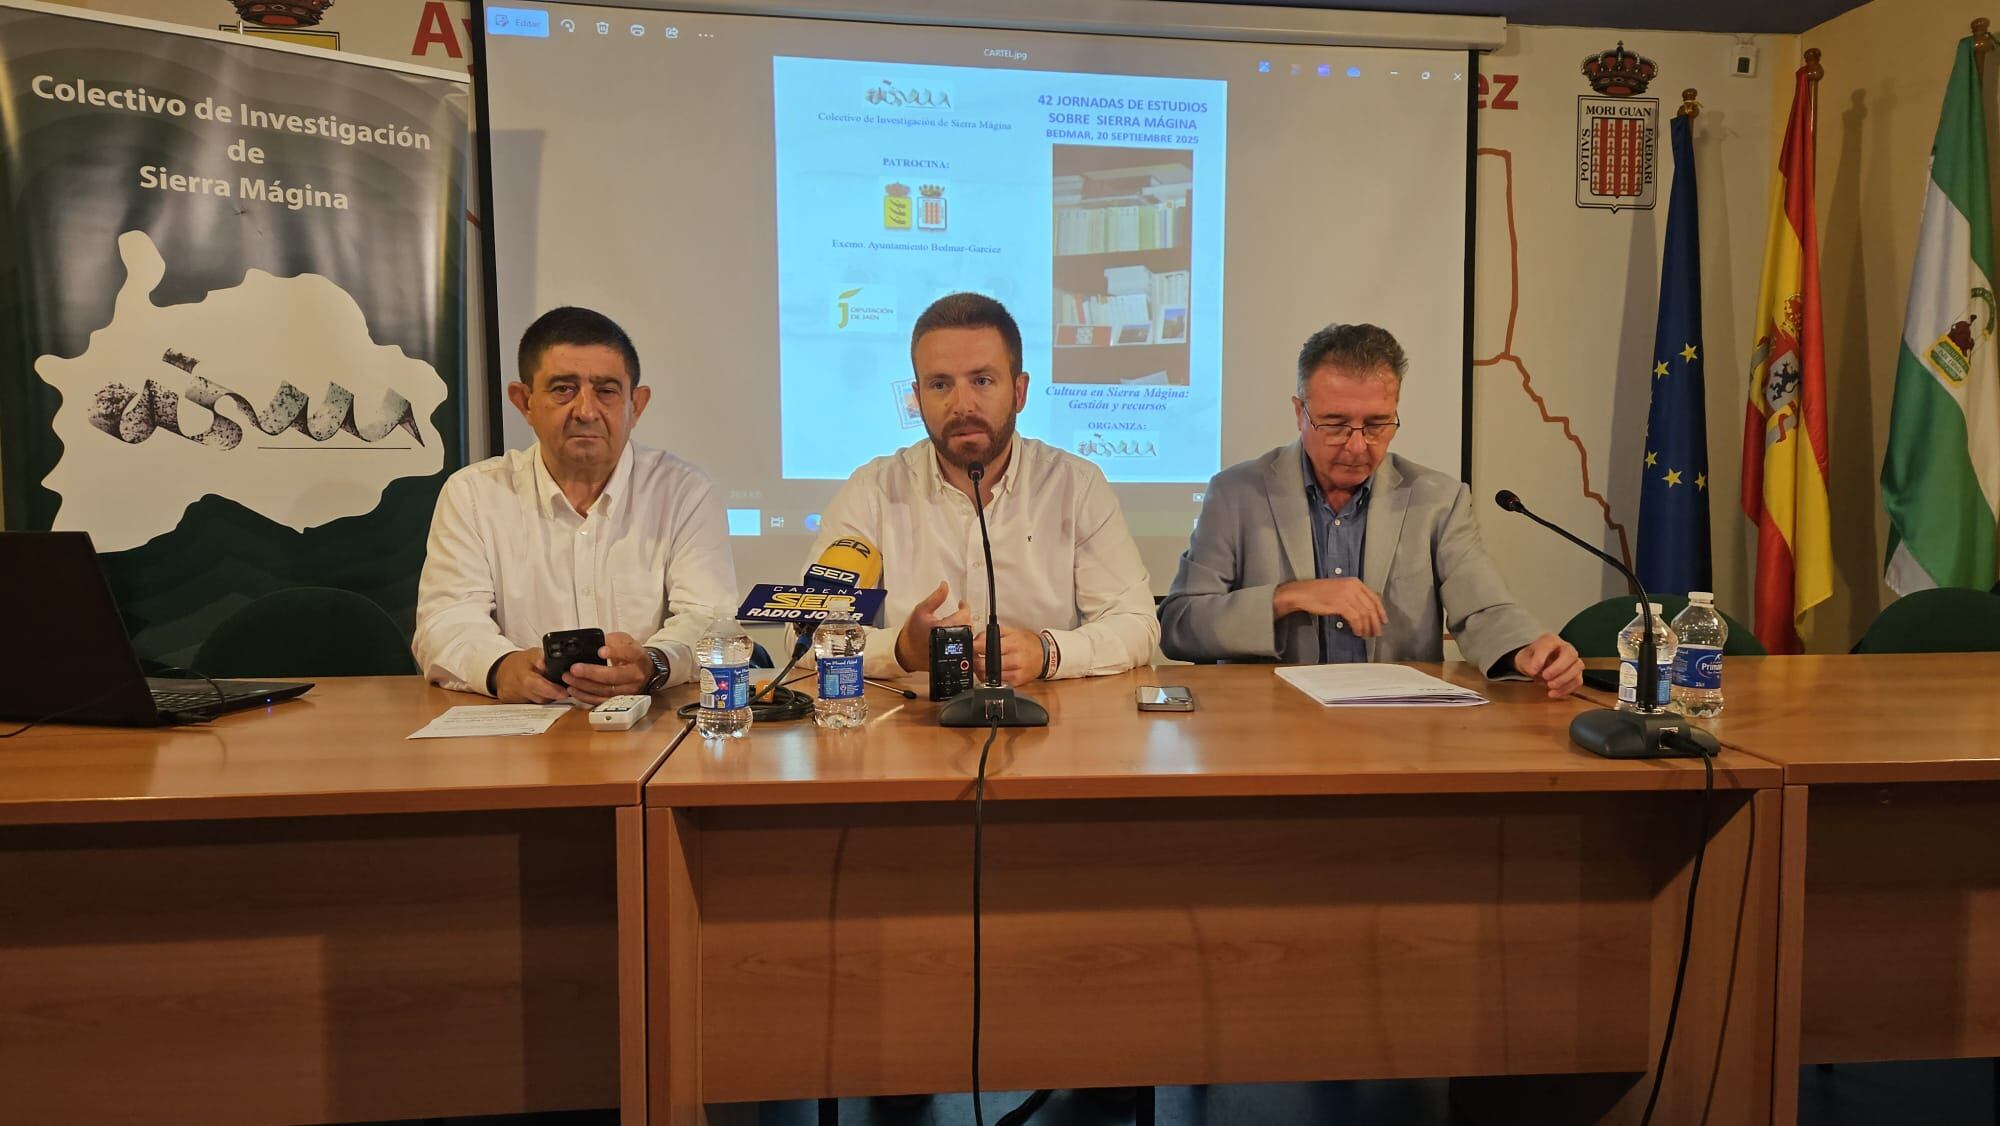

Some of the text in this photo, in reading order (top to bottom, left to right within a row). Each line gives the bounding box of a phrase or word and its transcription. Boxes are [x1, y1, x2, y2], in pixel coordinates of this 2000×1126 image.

[411, 1, 474, 76] A
[1037, 94, 1208, 113] 42 JORNADAS DE ESTUDIOS
[1585, 105, 1652, 117] MORI GUAN
[31, 74, 432, 151] Colectivo de Investigación
[818, 112, 862, 123] Colectivo
[863, 114, 875, 124] de
[937, 117, 949, 127] de
[950, 119, 977, 129] Sierra
[1048, 113, 1198, 130] SOBRE SIERRA MÁGINA
[1046, 129, 1199, 145] BEDMAR, 20 SEPTIEMBRE 2025
[227, 140, 265, 164] de
[1580, 128, 1591, 181] POTIVS
[883, 157, 950, 169] PATROCINA:
[139, 165, 349, 211] Sierra Mágina
[868, 241, 929, 252] Ayuntamiento
[1045, 385, 1190, 400] Cultura en Sierra Mágina:
[1068, 399, 1167, 412] Gestión y recursos
[1088, 421, 1147, 431] ORGANIZA:
[809, 565, 856, 583] SER
[772, 585, 863, 596] CADENA
[746, 608, 802, 619] RADIO
